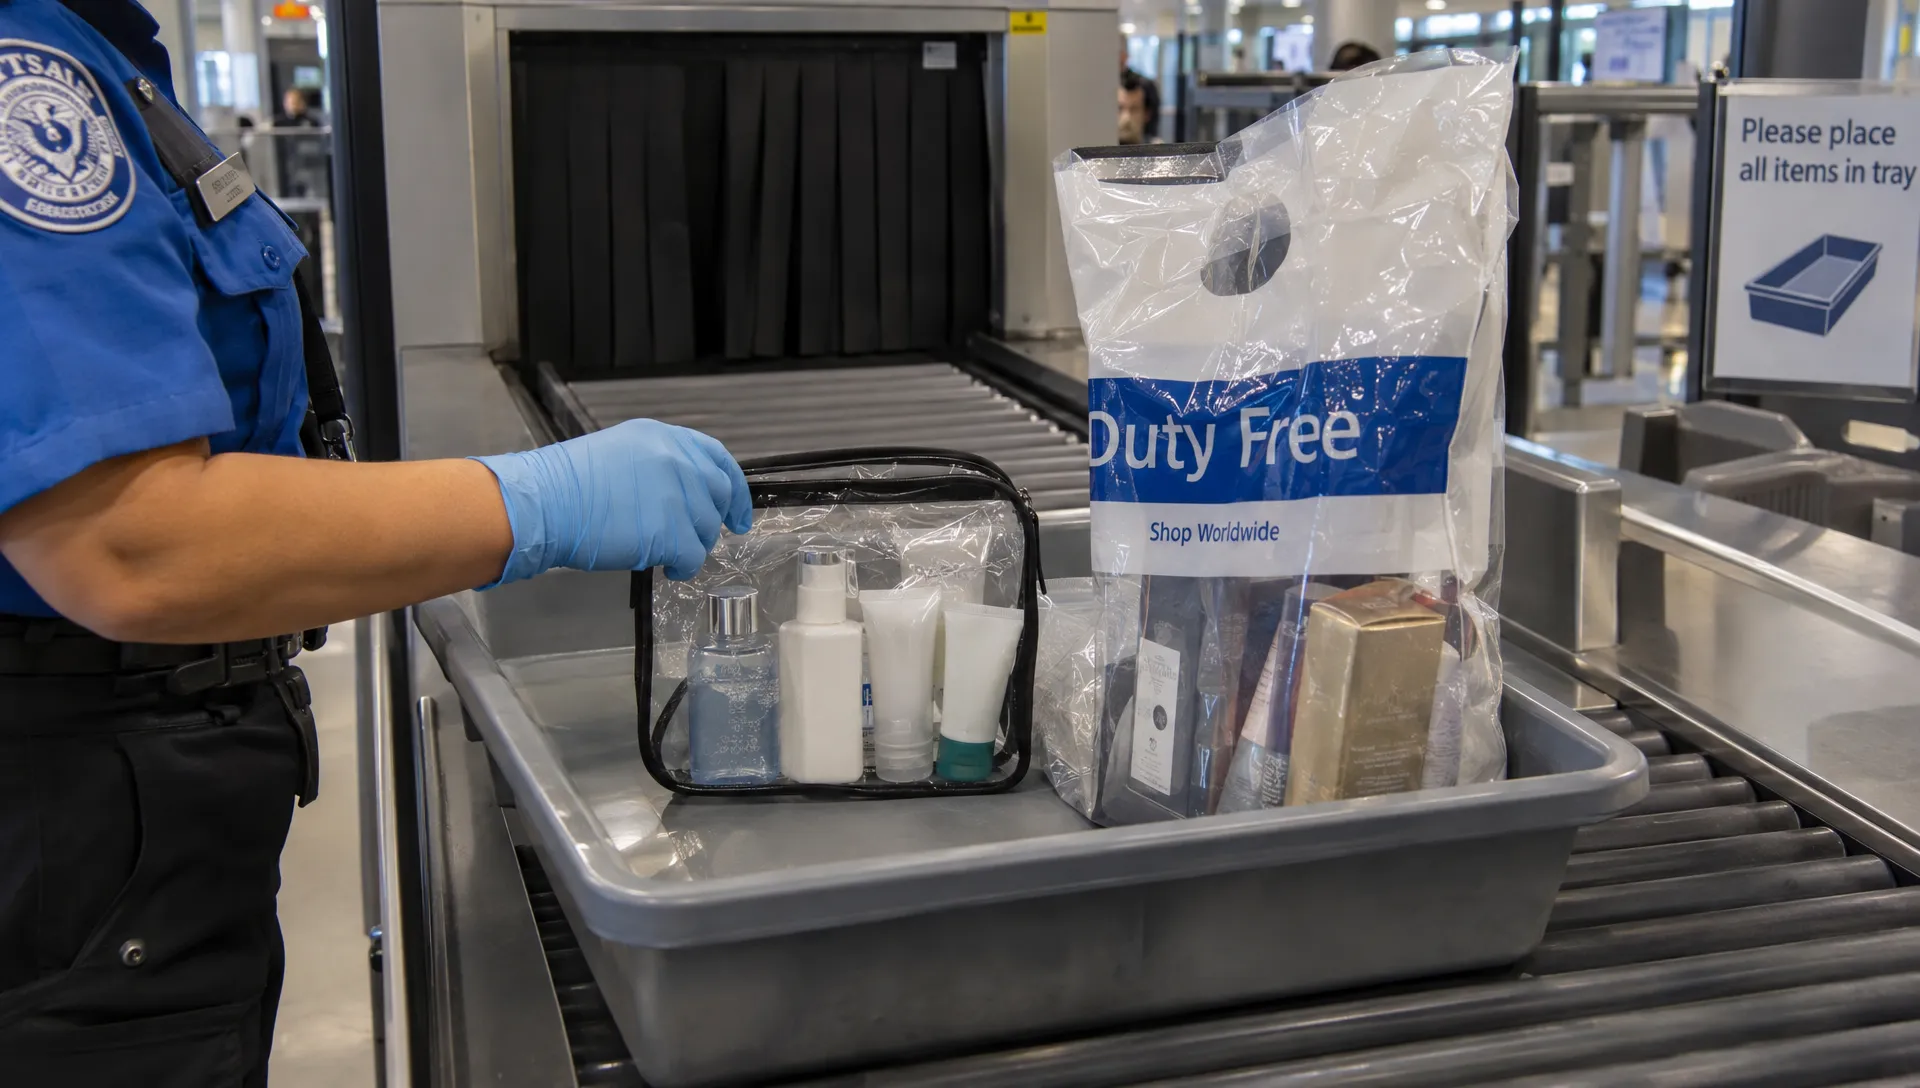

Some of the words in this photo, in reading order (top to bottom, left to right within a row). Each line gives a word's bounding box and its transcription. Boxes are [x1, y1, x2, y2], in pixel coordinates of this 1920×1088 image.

[1741, 117, 1823, 144] Please
[1829, 118, 1897, 150] place
[1739, 156, 1768, 182] all
[1774, 157, 1839, 184] items
[1845, 158, 1866, 184] in
[1872, 160, 1918, 191] tray
[1088, 410, 1216, 483] Duty
[1240, 407, 1361, 468] Free
[1149, 520, 1193, 547] Shop
[1197, 520, 1280, 543] Worldwide
